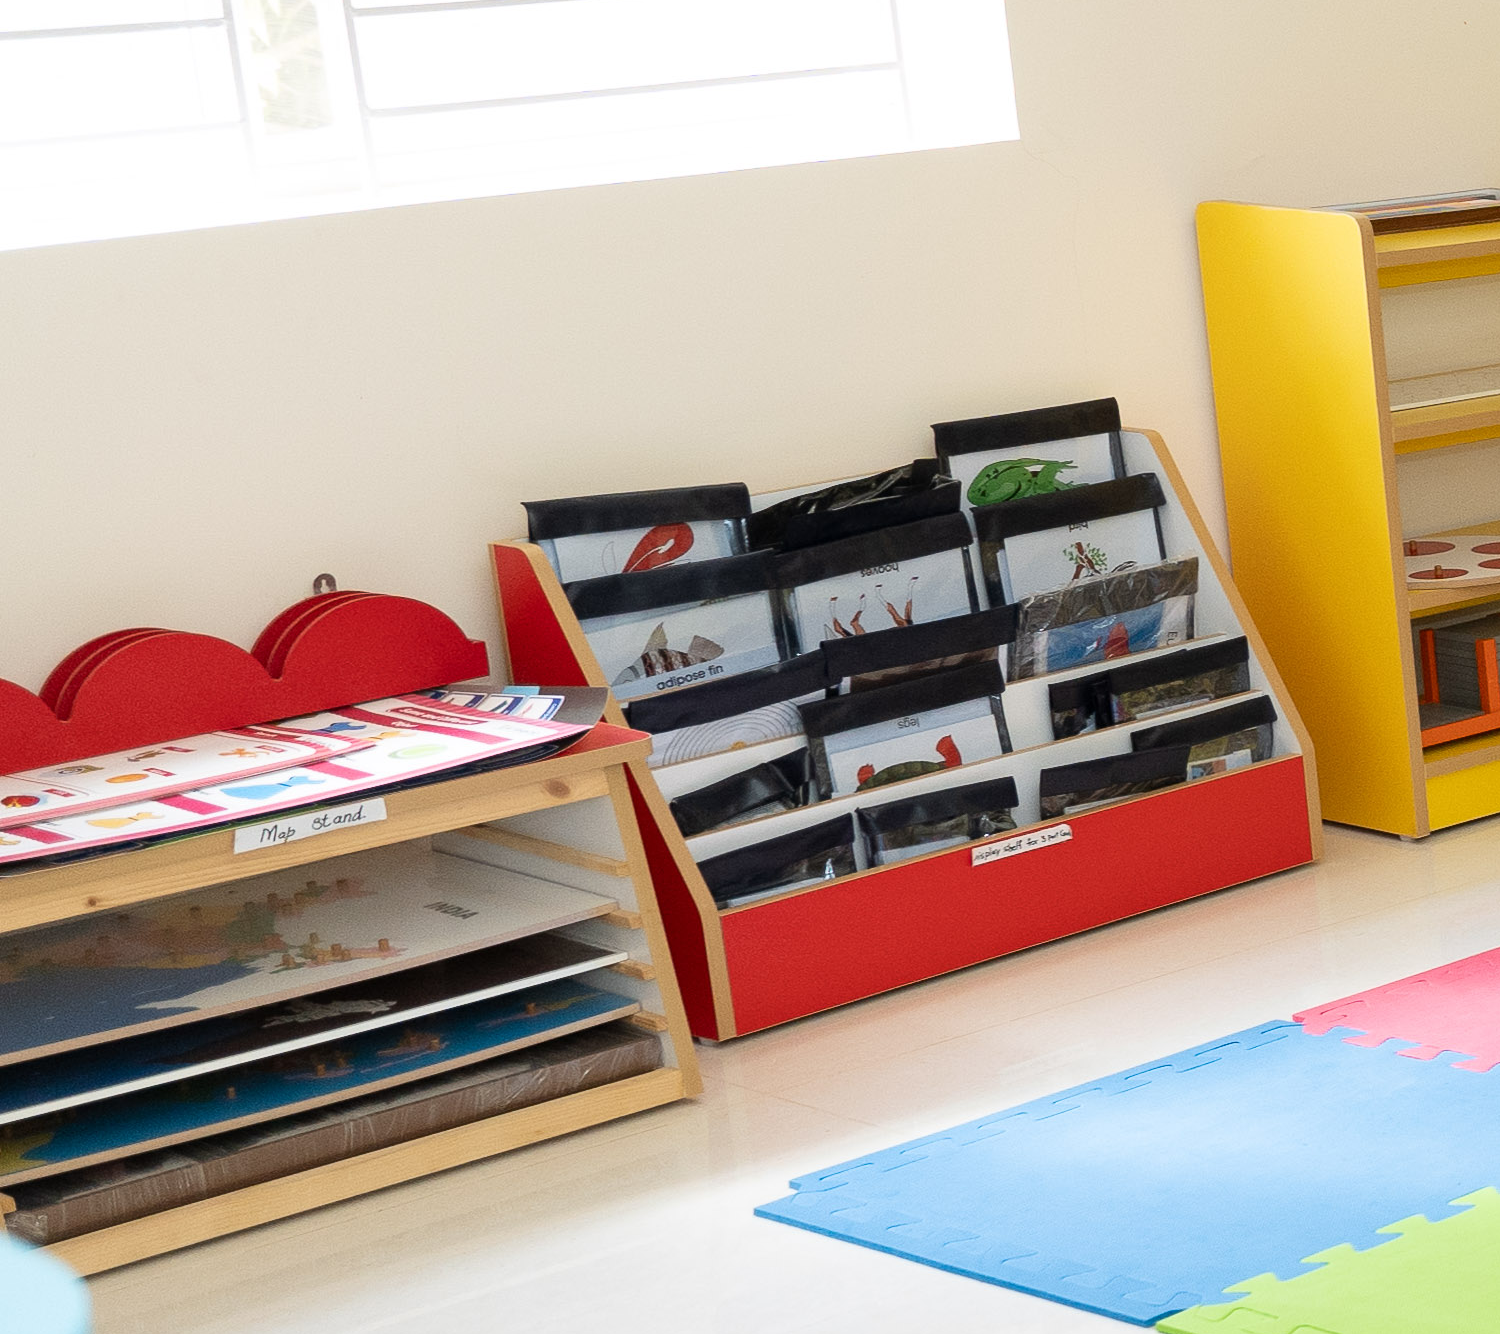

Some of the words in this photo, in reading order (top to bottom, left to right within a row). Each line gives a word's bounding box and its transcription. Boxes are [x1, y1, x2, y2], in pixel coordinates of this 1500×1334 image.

[860, 562, 900, 578] hooves
[656, 669, 706, 691] adipose
[708, 663, 724, 676] fin
[897, 717, 920, 729] legs
[260, 824, 296, 844] Map
